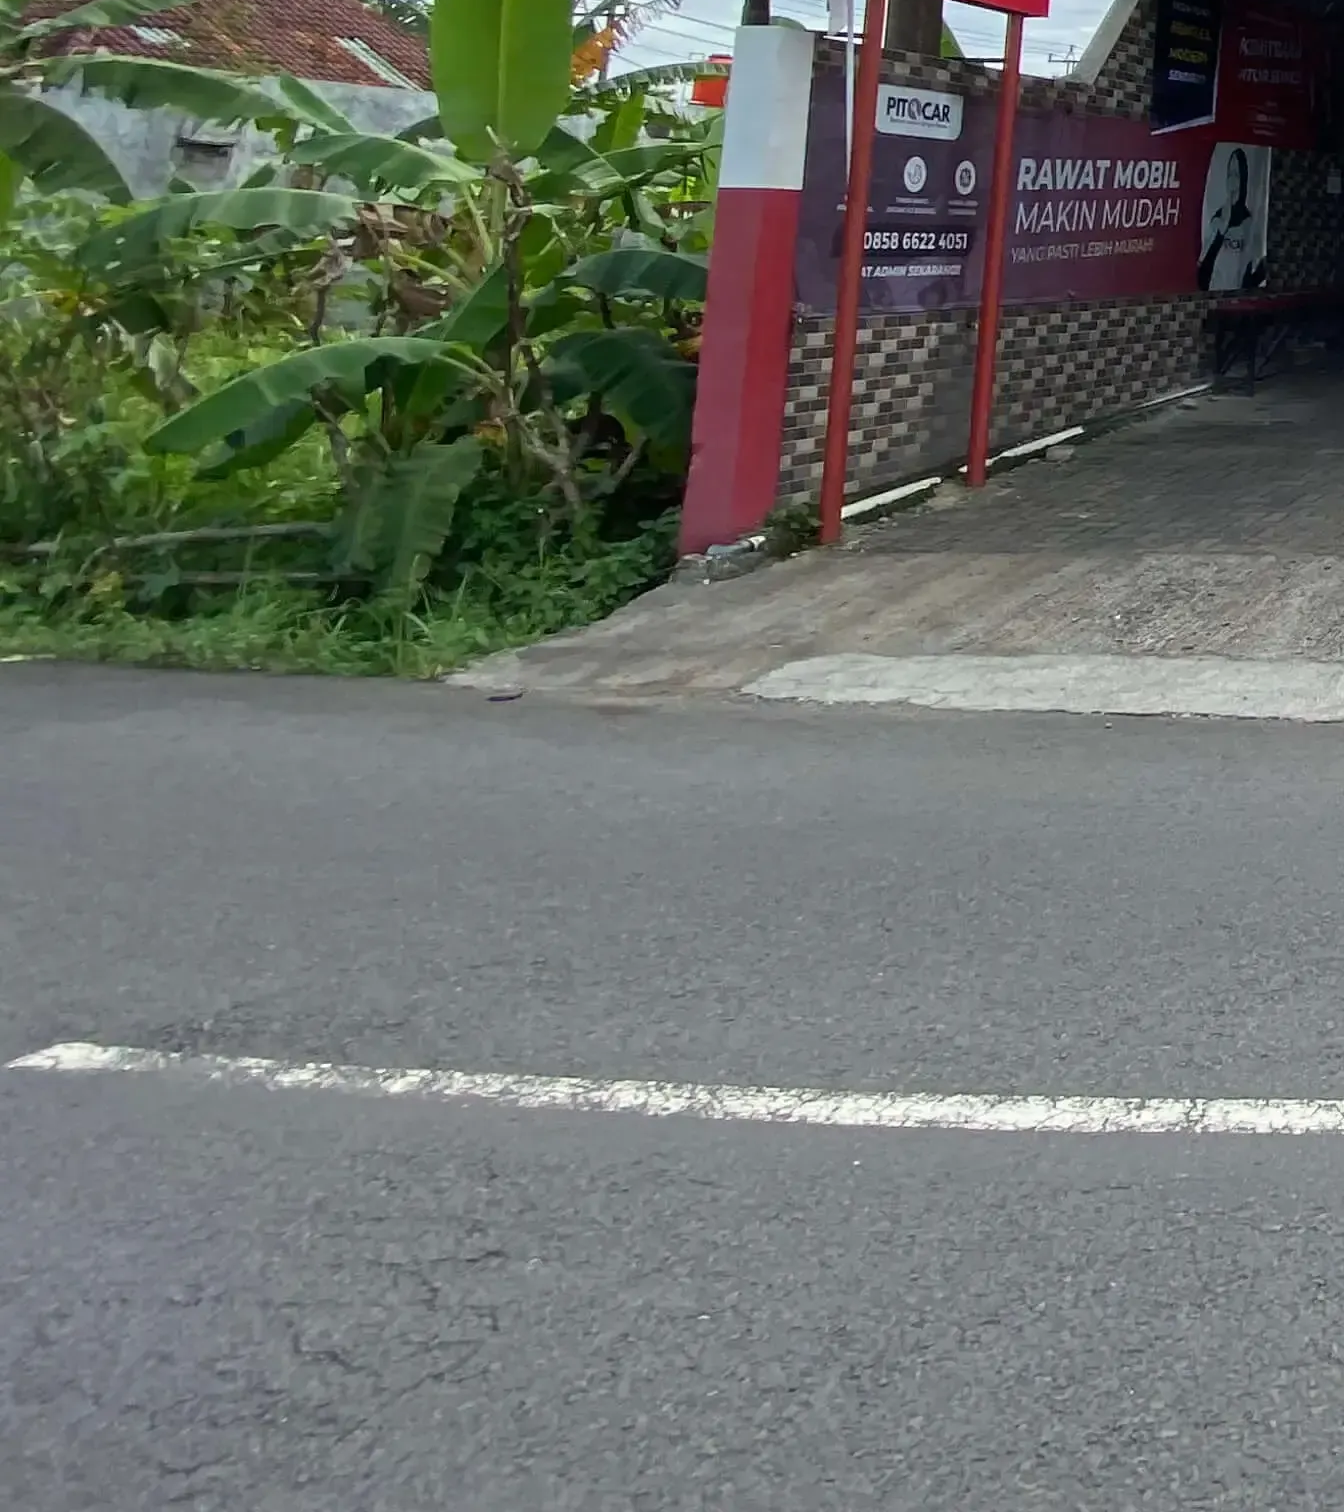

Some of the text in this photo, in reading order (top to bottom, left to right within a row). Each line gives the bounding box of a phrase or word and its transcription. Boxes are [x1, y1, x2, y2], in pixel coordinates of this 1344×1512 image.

[1016, 158, 1180, 191] RAWAT MOBIL
[1015, 201, 1096, 235] MAKIN
[1101, 198, 1180, 230] MUDAH
[863, 231, 968, 250] 0858 6622 4051
[1011, 246, 1046, 264] YANG
[1047, 243, 1080, 261] PASTI
